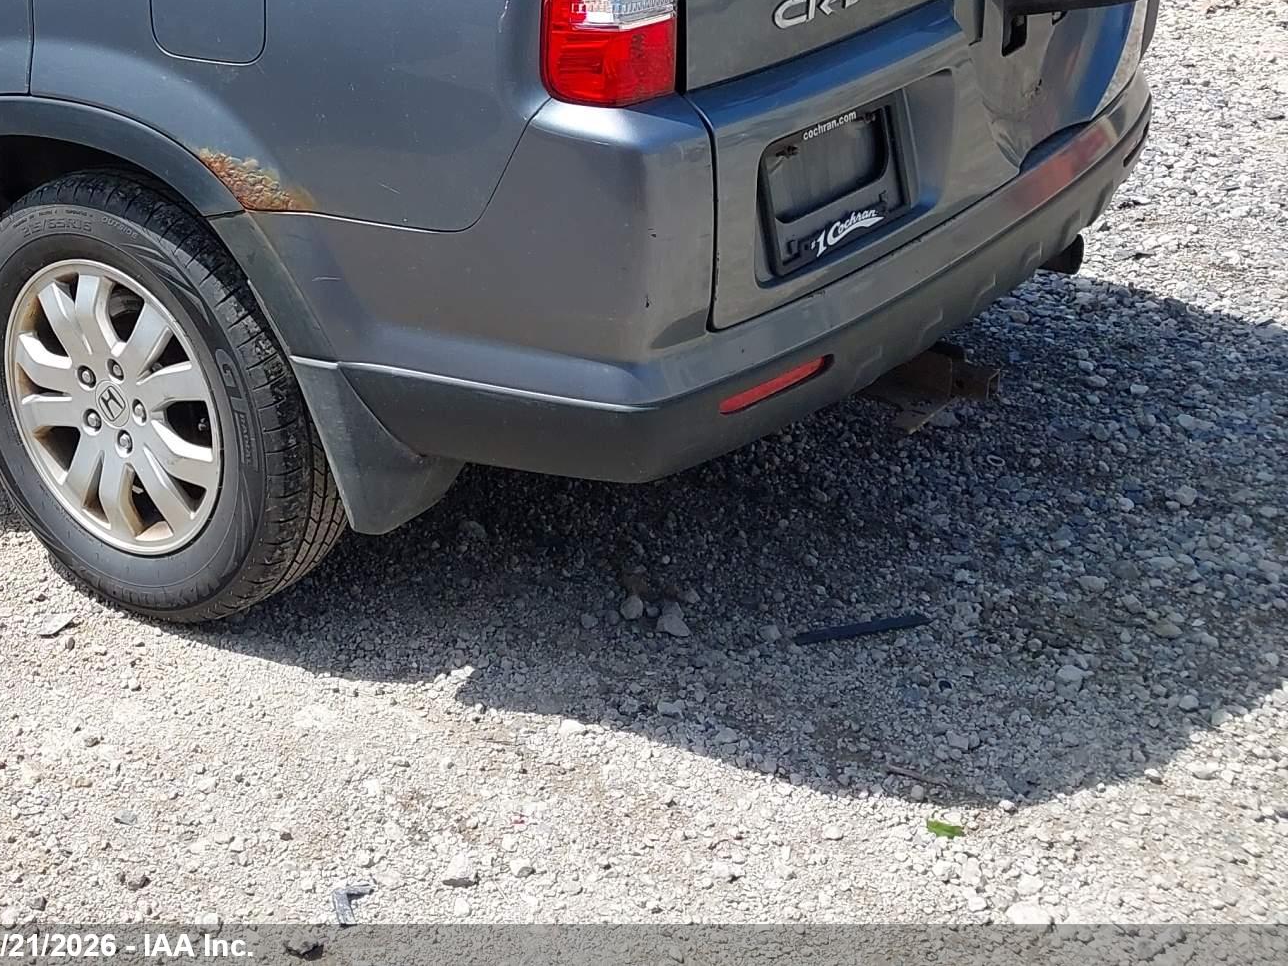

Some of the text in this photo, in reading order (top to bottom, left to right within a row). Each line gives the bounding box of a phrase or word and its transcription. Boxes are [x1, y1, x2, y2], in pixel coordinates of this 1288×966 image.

[802, 110, 858, 141] cochran.com
[101, 215, 138, 242] OUTSIDE
[826, 208, 880, 247] Cochran
